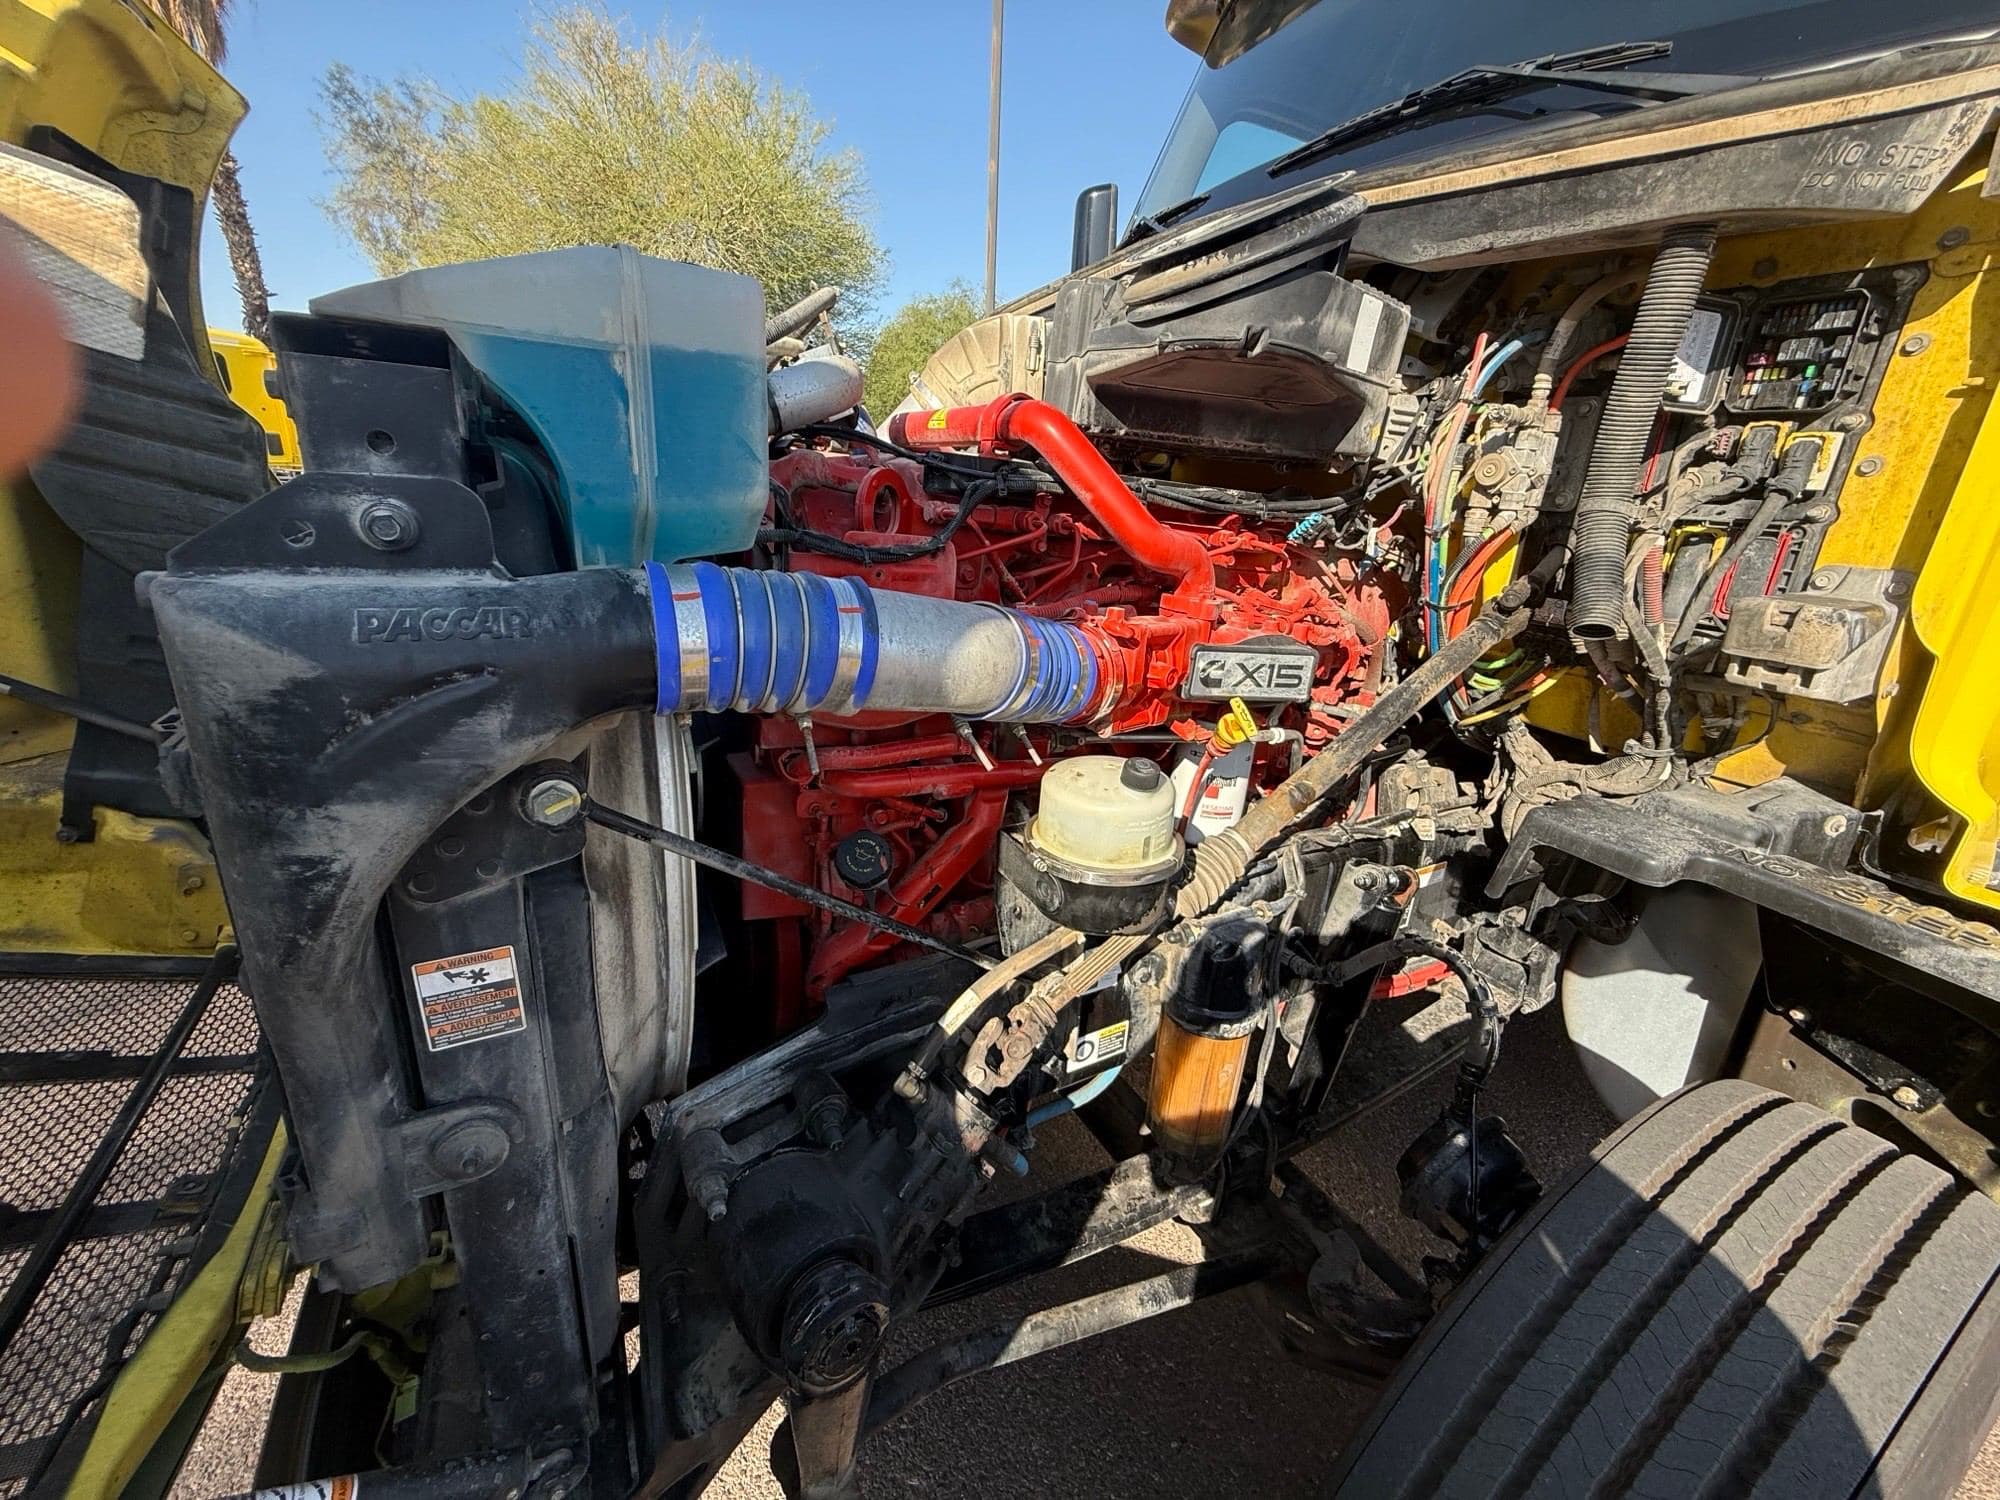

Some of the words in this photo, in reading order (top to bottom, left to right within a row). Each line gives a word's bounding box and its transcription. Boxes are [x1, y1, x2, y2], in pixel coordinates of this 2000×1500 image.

[1817, 141, 1867, 168] NO
[1879, 142, 1948, 169] STEP
[1803, 171, 1836, 189] DO
[1845, 171, 1887, 189] NOT
[1891, 172, 1934, 192] PULL
[351, 606, 532, 643] PACCAR
[1231, 661, 1304, 689] X15
[1721, 841, 1800, 879] NO
[1831, 885, 1996, 946] STEP
[447, 952, 495, 968] WARNING
[441, 989, 515, 1011] AVERTISSEMENT
[450, 1011, 515, 1031] ADVERTENCIA
